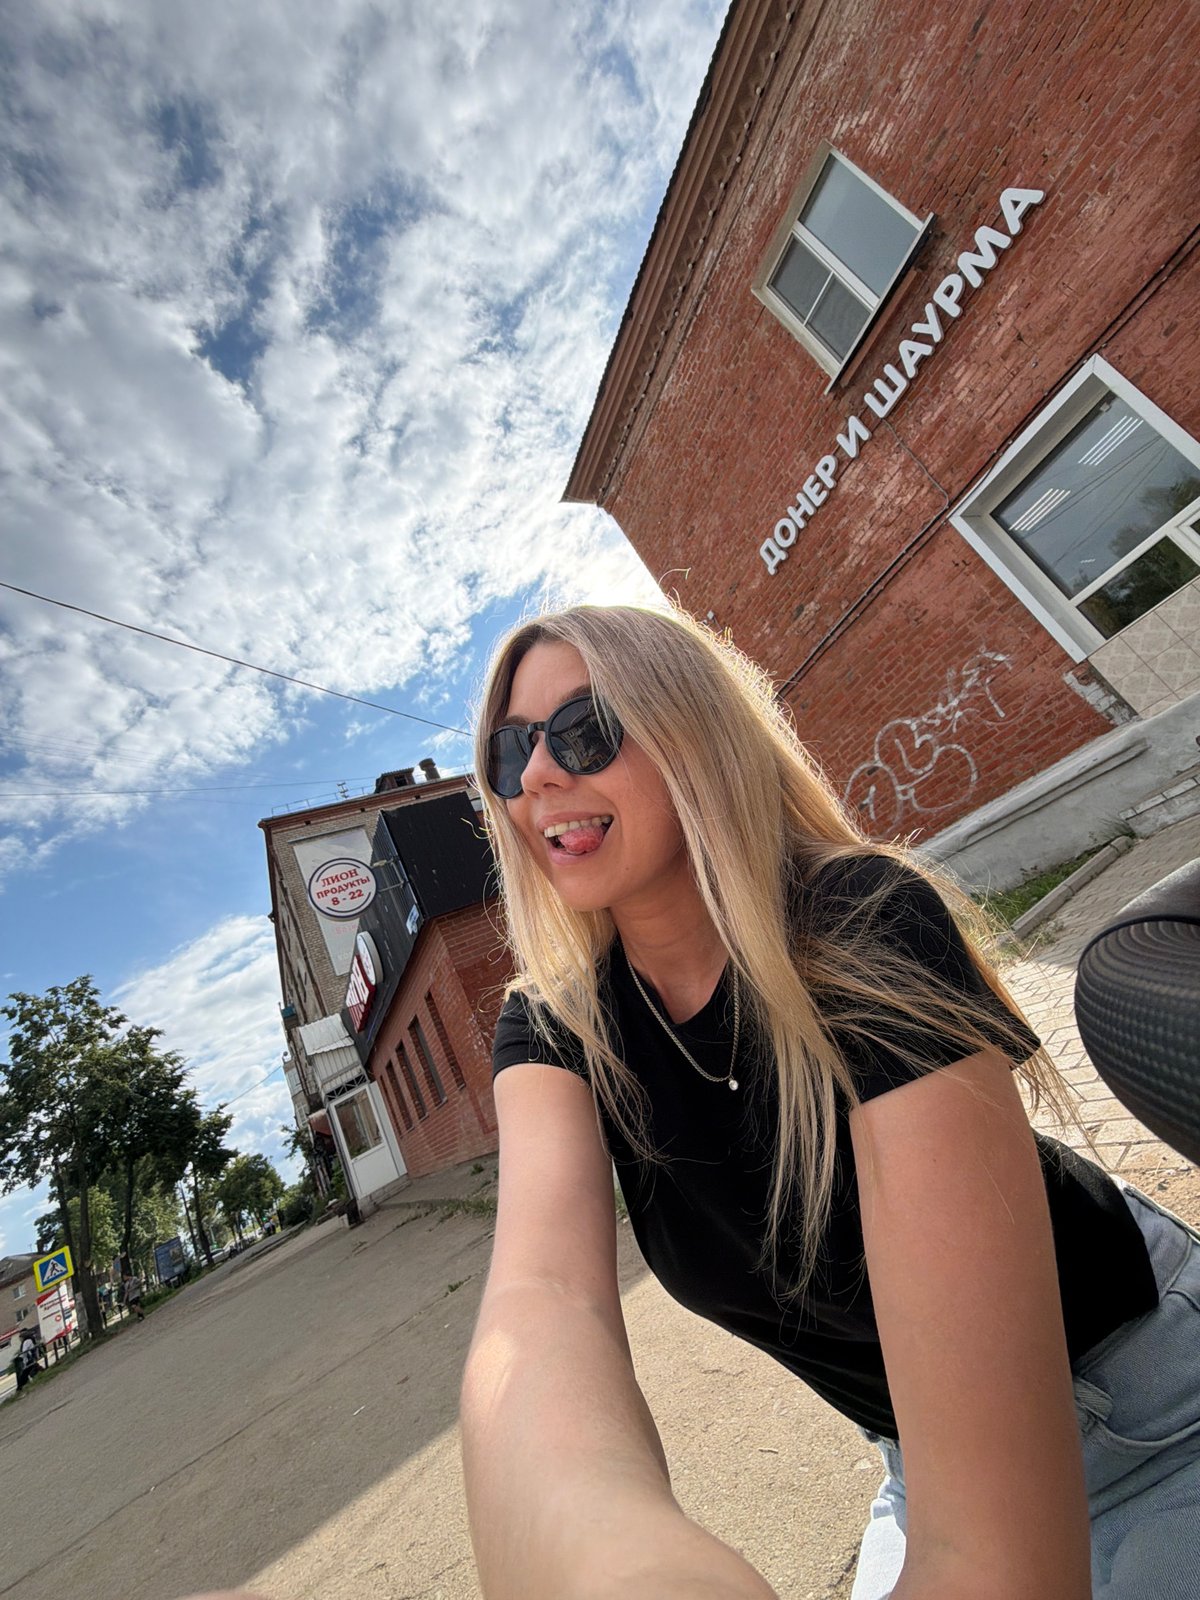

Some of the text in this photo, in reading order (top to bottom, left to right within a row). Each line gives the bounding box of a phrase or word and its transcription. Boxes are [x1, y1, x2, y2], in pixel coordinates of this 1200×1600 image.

[758, 187, 1046, 576] ДОНЕР И ШАУРМА
[316, 876, 371, 899] ПРОДУКТЫ
[321, 868, 359, 887] ЛИОН
[331, 897, 340, 906] 8
[348, 889, 364, 900] 22
